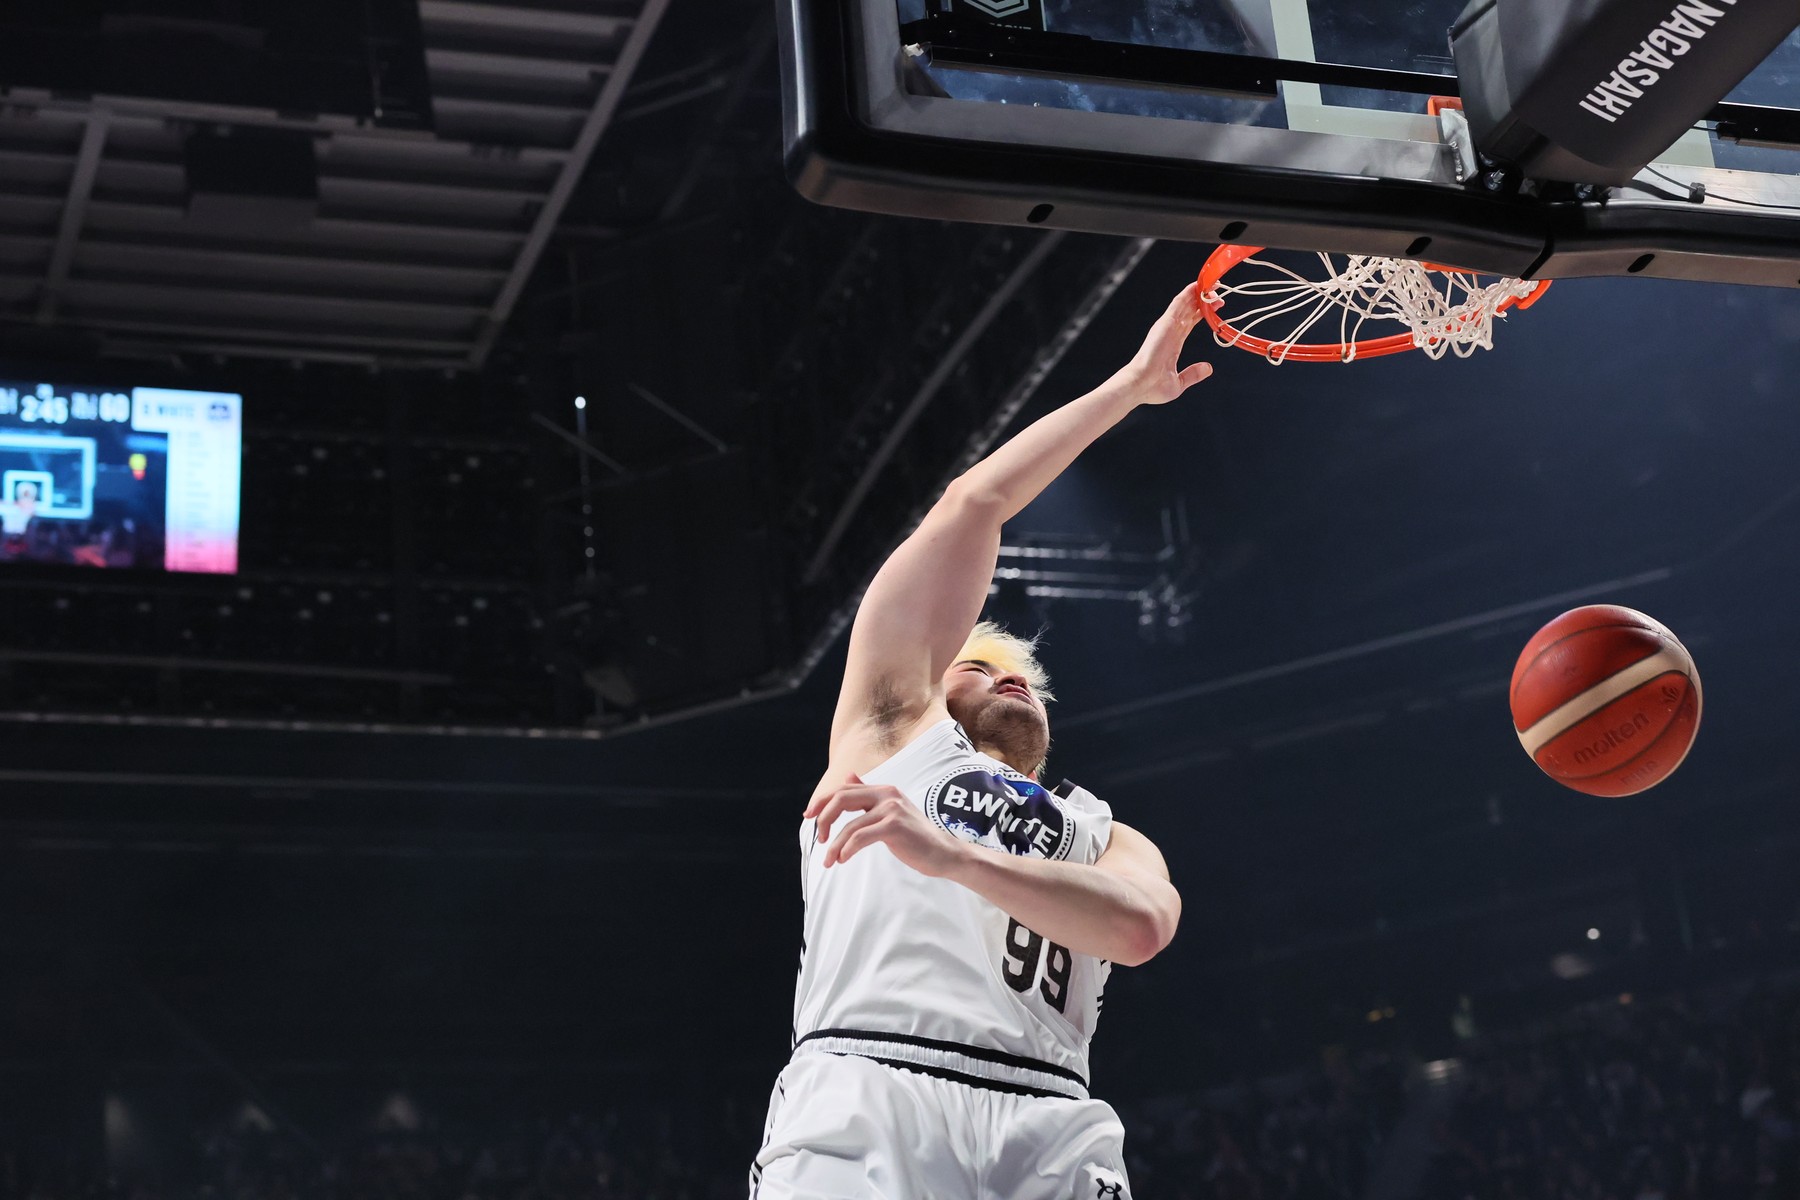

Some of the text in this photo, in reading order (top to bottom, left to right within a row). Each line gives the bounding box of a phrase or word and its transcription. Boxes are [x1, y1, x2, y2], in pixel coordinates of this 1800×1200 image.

[1578, 0, 1726, 123] NAGASAKI
[1574, 712, 1650, 765] molten
[943, 784, 1059, 854] B.WHITE
[1002, 916, 1072, 1015] 99
